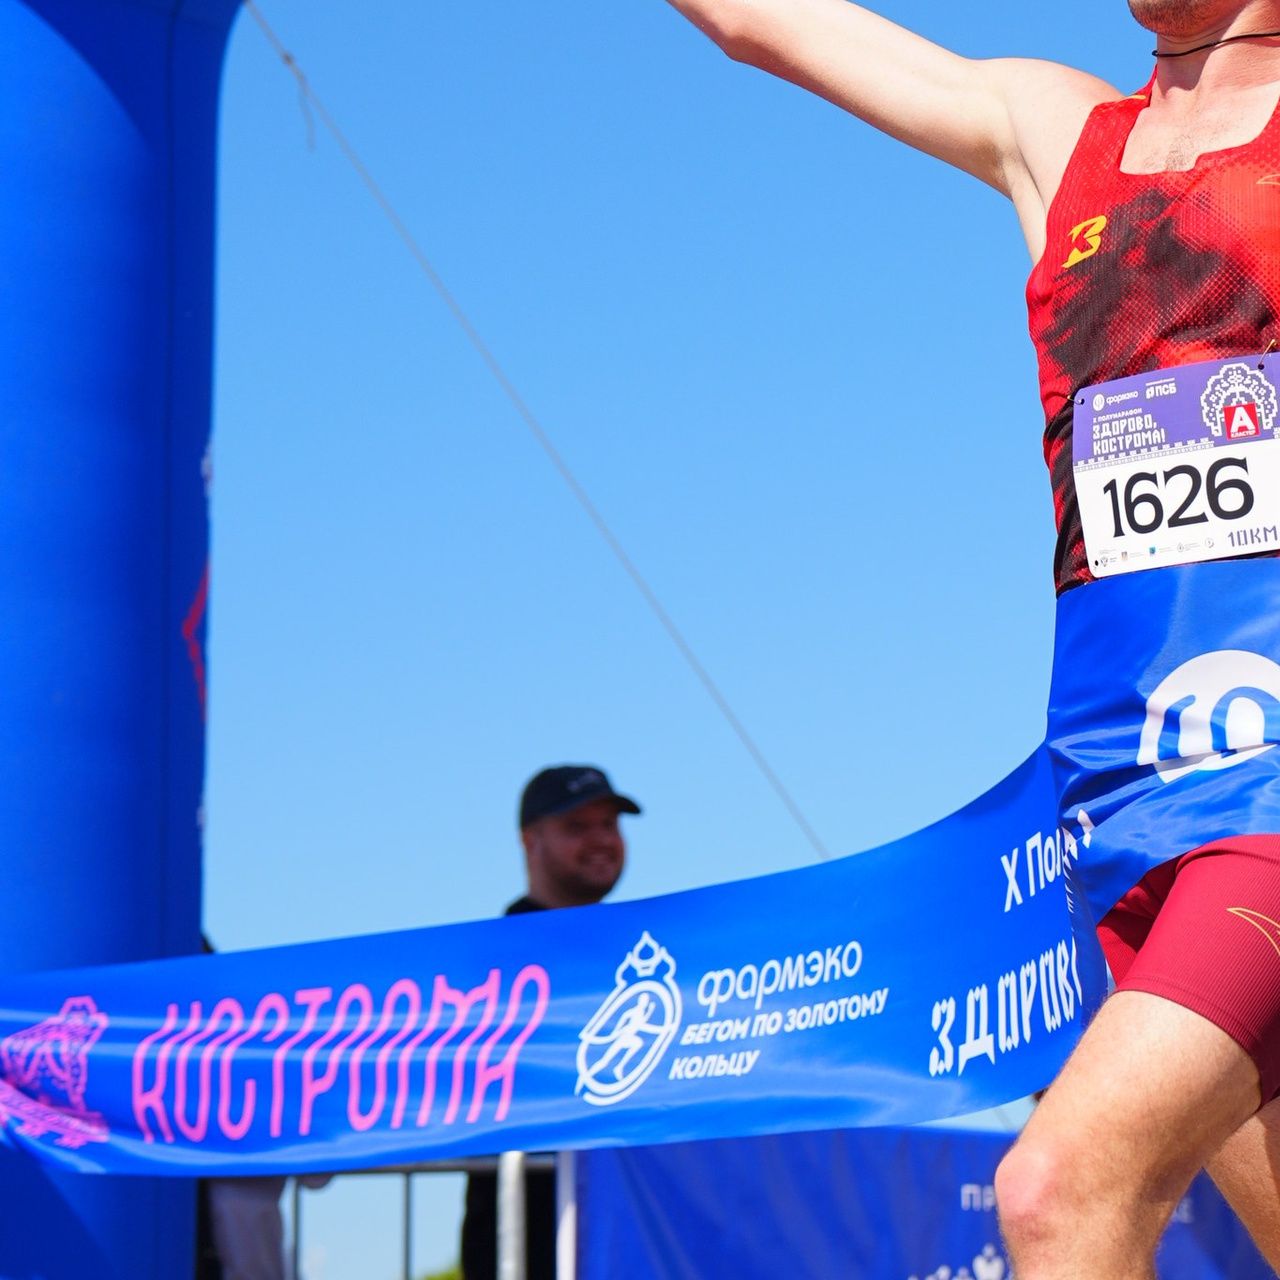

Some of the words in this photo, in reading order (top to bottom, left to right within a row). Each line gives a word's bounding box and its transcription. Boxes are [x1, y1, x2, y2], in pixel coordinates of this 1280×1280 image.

[1155, 382, 1177, 397] ПСБ
[1092, 414, 1157, 440] ЗДОРОВО,
[1098, 408, 1143, 423] ПОЛУМАРАФОН
[1093, 428, 1166, 456] КОСТРОМА!
[1230, 429, 1257, 439] КЛАСТЕР
[1103, 457, 1255, 538] 1626
[697, 940, 863, 1018] фармэко
[679, 1016, 751, 1045] БЕГОМ
[751, 1011, 783, 1038] ПО
[784, 987, 889, 1033] ЗОЛОТОМУ
[132, 963, 551, 1144] КОСТРОМА
[668, 1049, 761, 1081] КОЛЬЦУ
